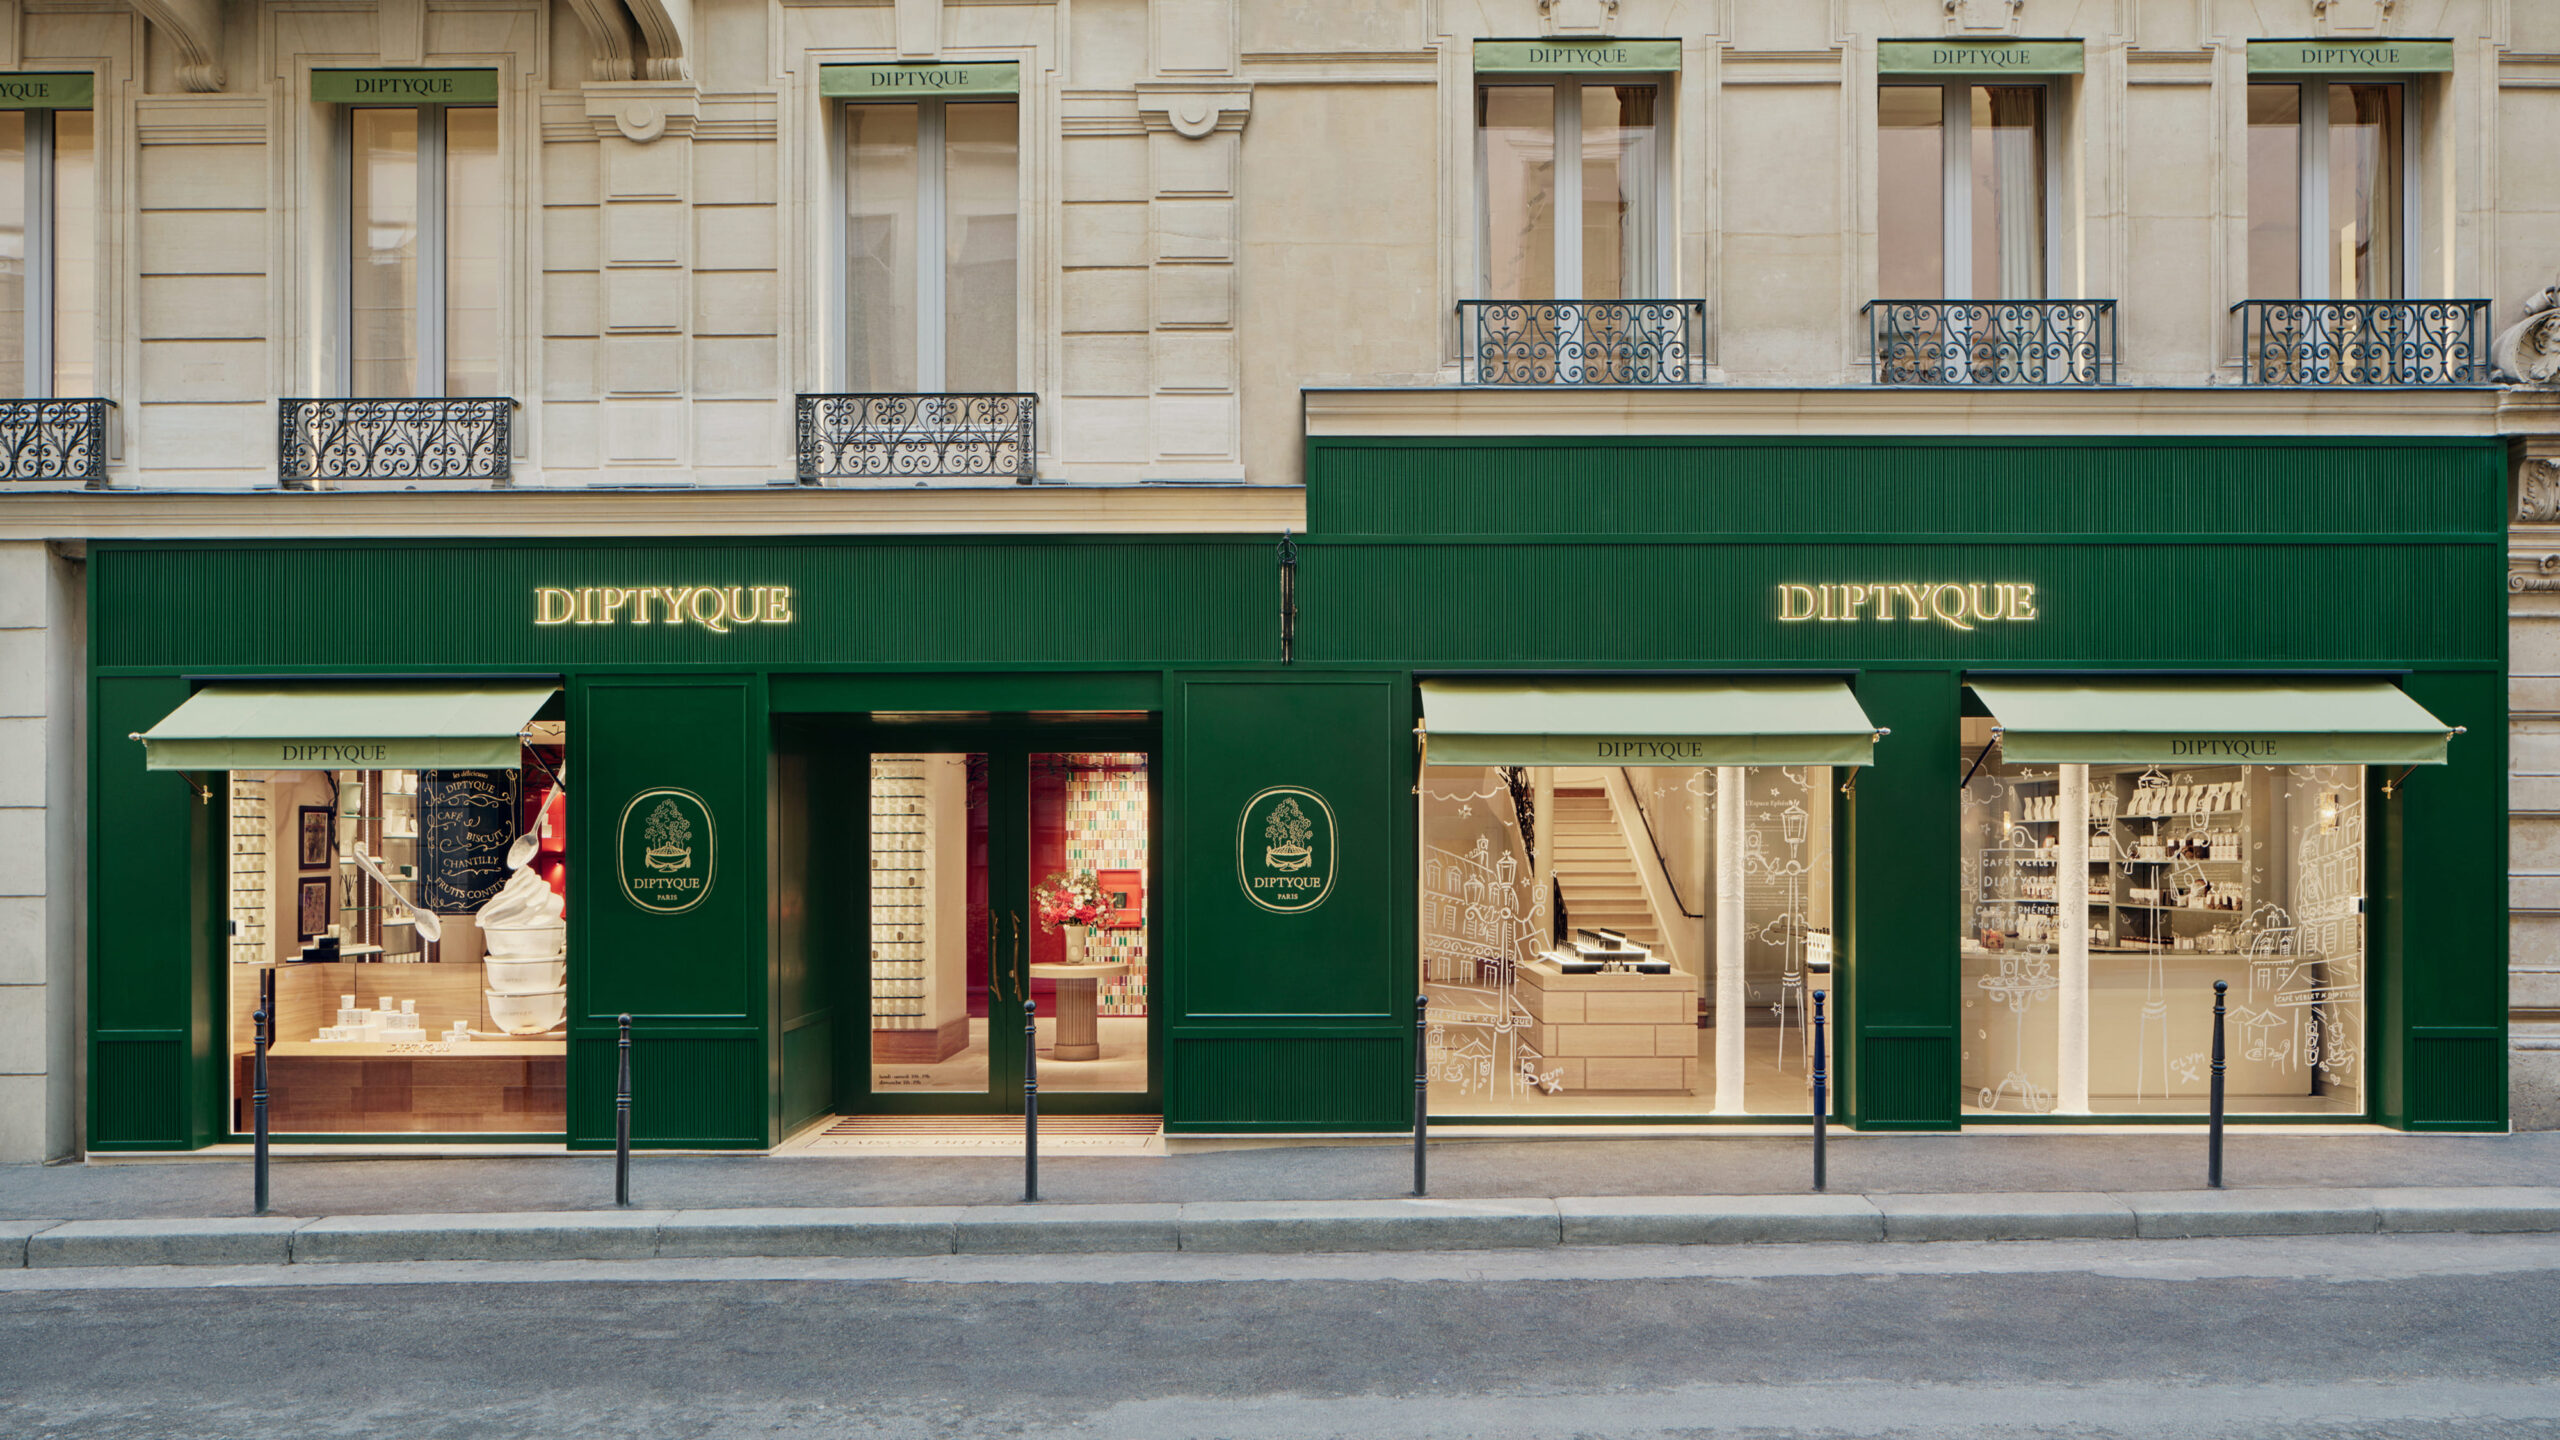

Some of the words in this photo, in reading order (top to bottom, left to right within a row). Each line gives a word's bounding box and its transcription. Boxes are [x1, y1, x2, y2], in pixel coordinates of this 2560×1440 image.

[1529, 48, 1627, 66] DIPTYQUE
[1932, 49, 2030, 67] DIPTYQUE
[2301, 48, 2399, 67] DIPTYQUE
[355, 78, 453, 96] DIPTYQUE
[871, 70, 969, 88] DIPTYQUE
[534, 585, 791, 633] DIPTYQUE
[1778, 583, 2036, 630] DIPTYQUE
[282, 744, 386, 765] DIPTYQUE
[1597, 742, 1703, 761] DIPTYQUE
[2171, 739, 2277, 758] DIPTYQUE
[445, 780, 496, 793] DIPTYQUE
[438, 811, 463, 822] CAFÉ
[466, 829, 504, 842] BISCUIT
[443, 855, 499, 868] CHANTILLY
[435, 876, 465, 899] FRUITS
[466, 877, 507, 899] CONFITS
[634, 878, 700, 891] DIPTYQUE
[1254, 877, 1321, 890] DIPTYQUE
